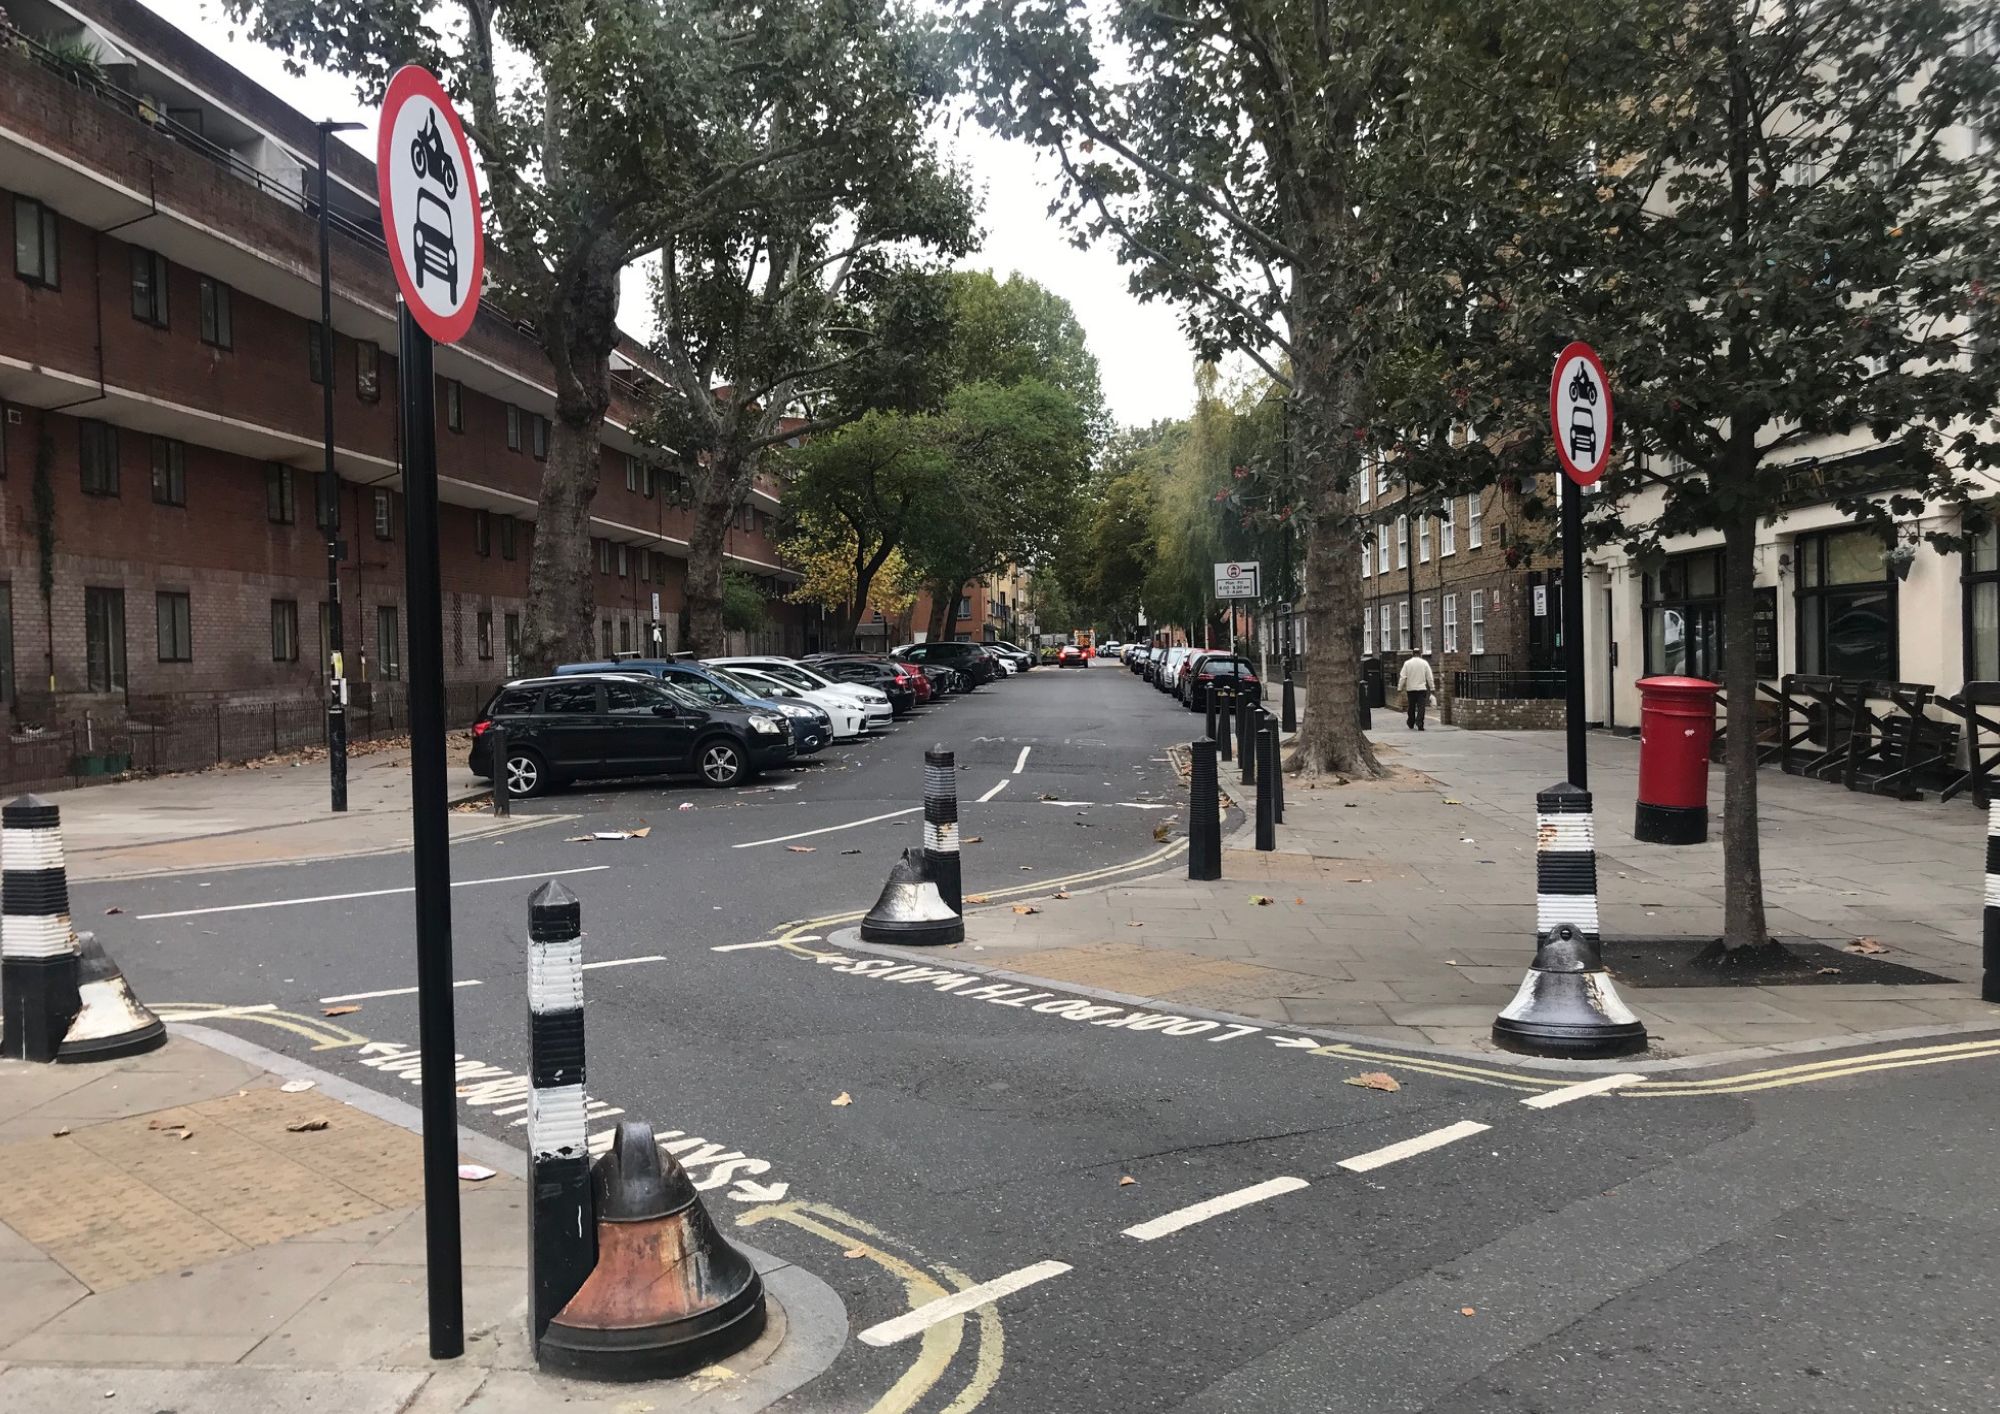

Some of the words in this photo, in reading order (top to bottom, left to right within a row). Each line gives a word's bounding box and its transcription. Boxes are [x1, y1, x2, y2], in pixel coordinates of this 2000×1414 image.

[832, 959, 981, 992] WAYS
[953, 983, 1125, 1021] BOTH
[1090, 1010, 1263, 1042] LOOK
